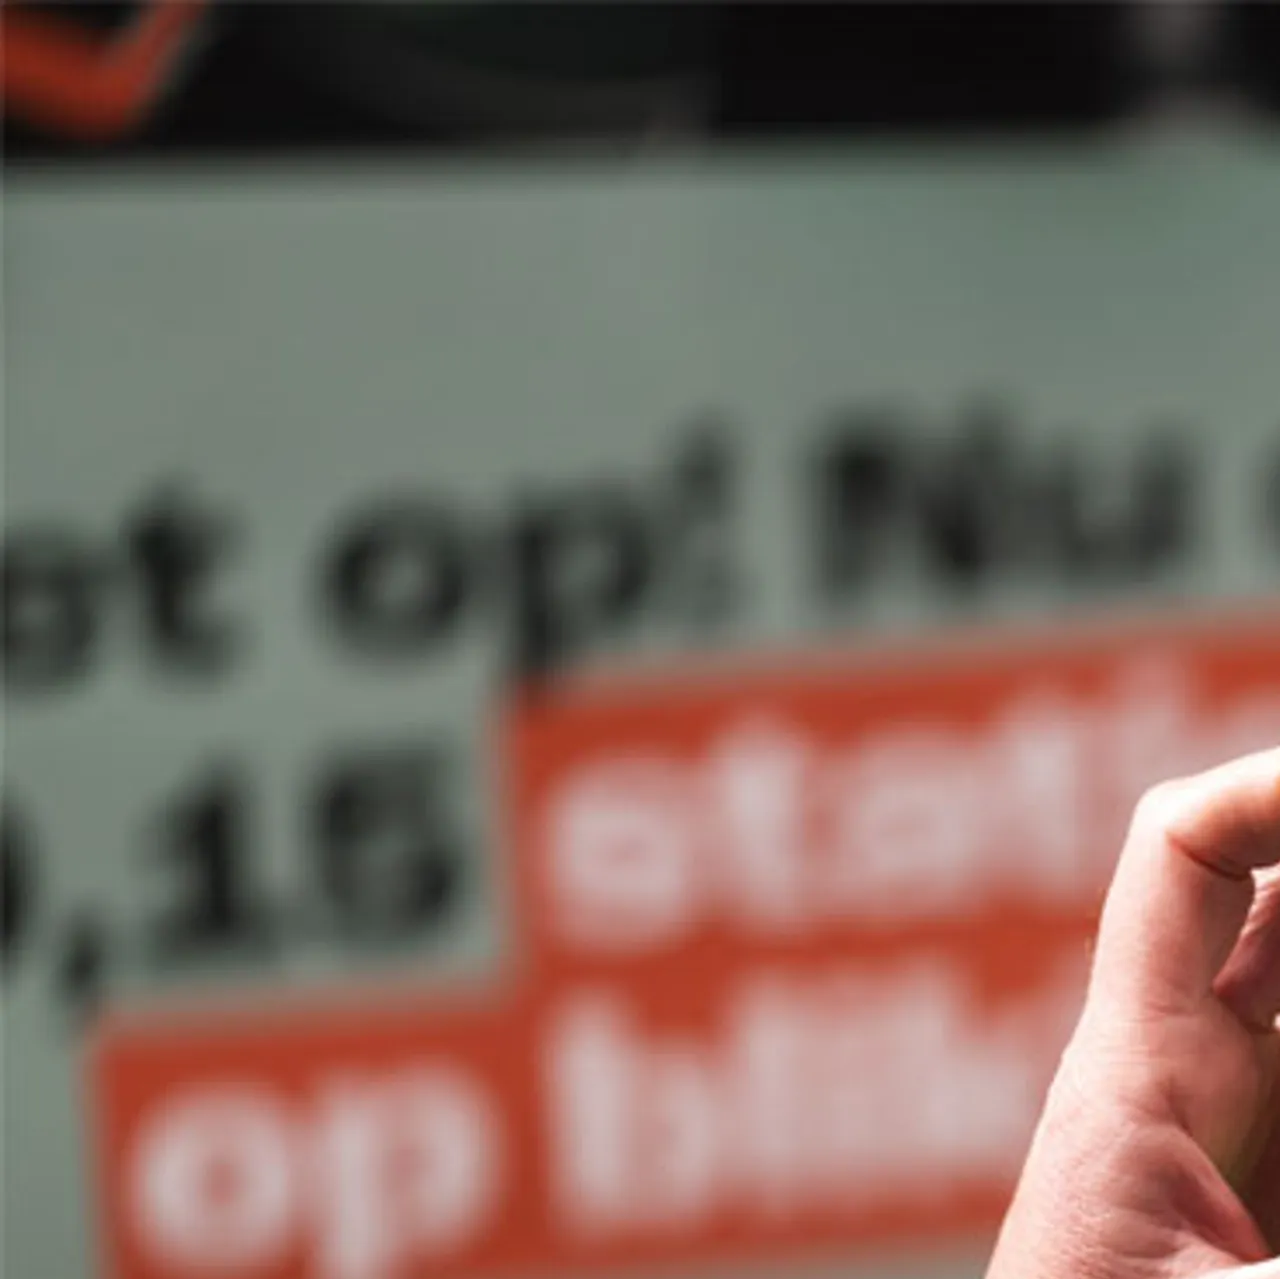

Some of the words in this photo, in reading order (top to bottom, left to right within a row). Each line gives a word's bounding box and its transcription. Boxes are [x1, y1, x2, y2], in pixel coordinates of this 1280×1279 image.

[815, 400, 1192, 598] Nu
[0, 750, 462, 1005] ,15
[548, 960, 1085, 1242] blik
